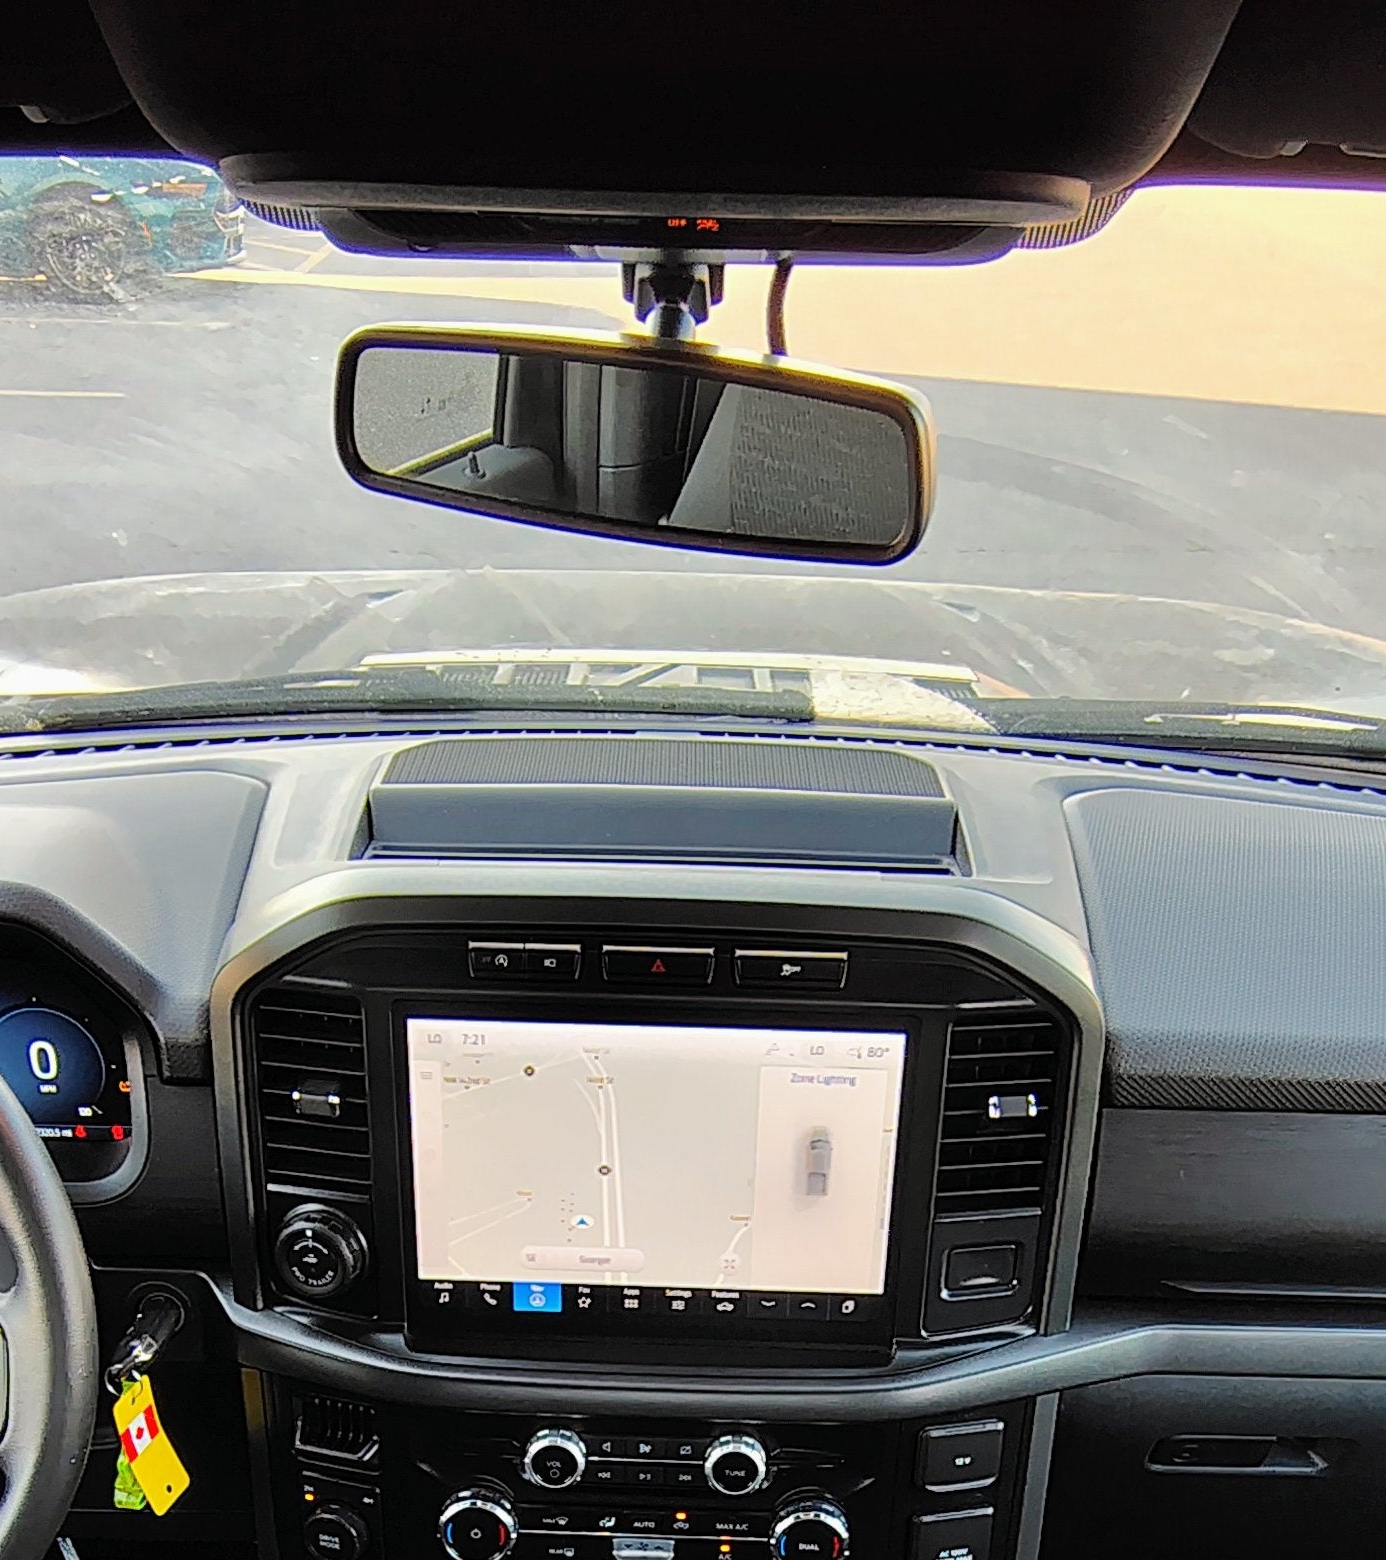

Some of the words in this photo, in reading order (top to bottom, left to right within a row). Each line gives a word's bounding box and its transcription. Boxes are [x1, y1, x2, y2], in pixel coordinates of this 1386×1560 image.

[461, 1033, 486, 1046] 7:21
[29, 1040, 58, 1080] 0
[790, 1073, 815, 1084] Zone
[816, 1074, 857, 1087] Lighting
[480, 1283, 501, 1292] Phone
[623, 1288, 640, 1297] Apps
[665, 1288, 692, 1298] Settings
[724, 1469, 746, 1478] TUNE
[633, 1521, 655, 1529] AUTO
[715, 1522, 734, 1531] MAX
[734, 1523, 749, 1531] A/C
[798, 1542, 820, 1551] DUAL
[718, 1553, 732, 1560] A/C
